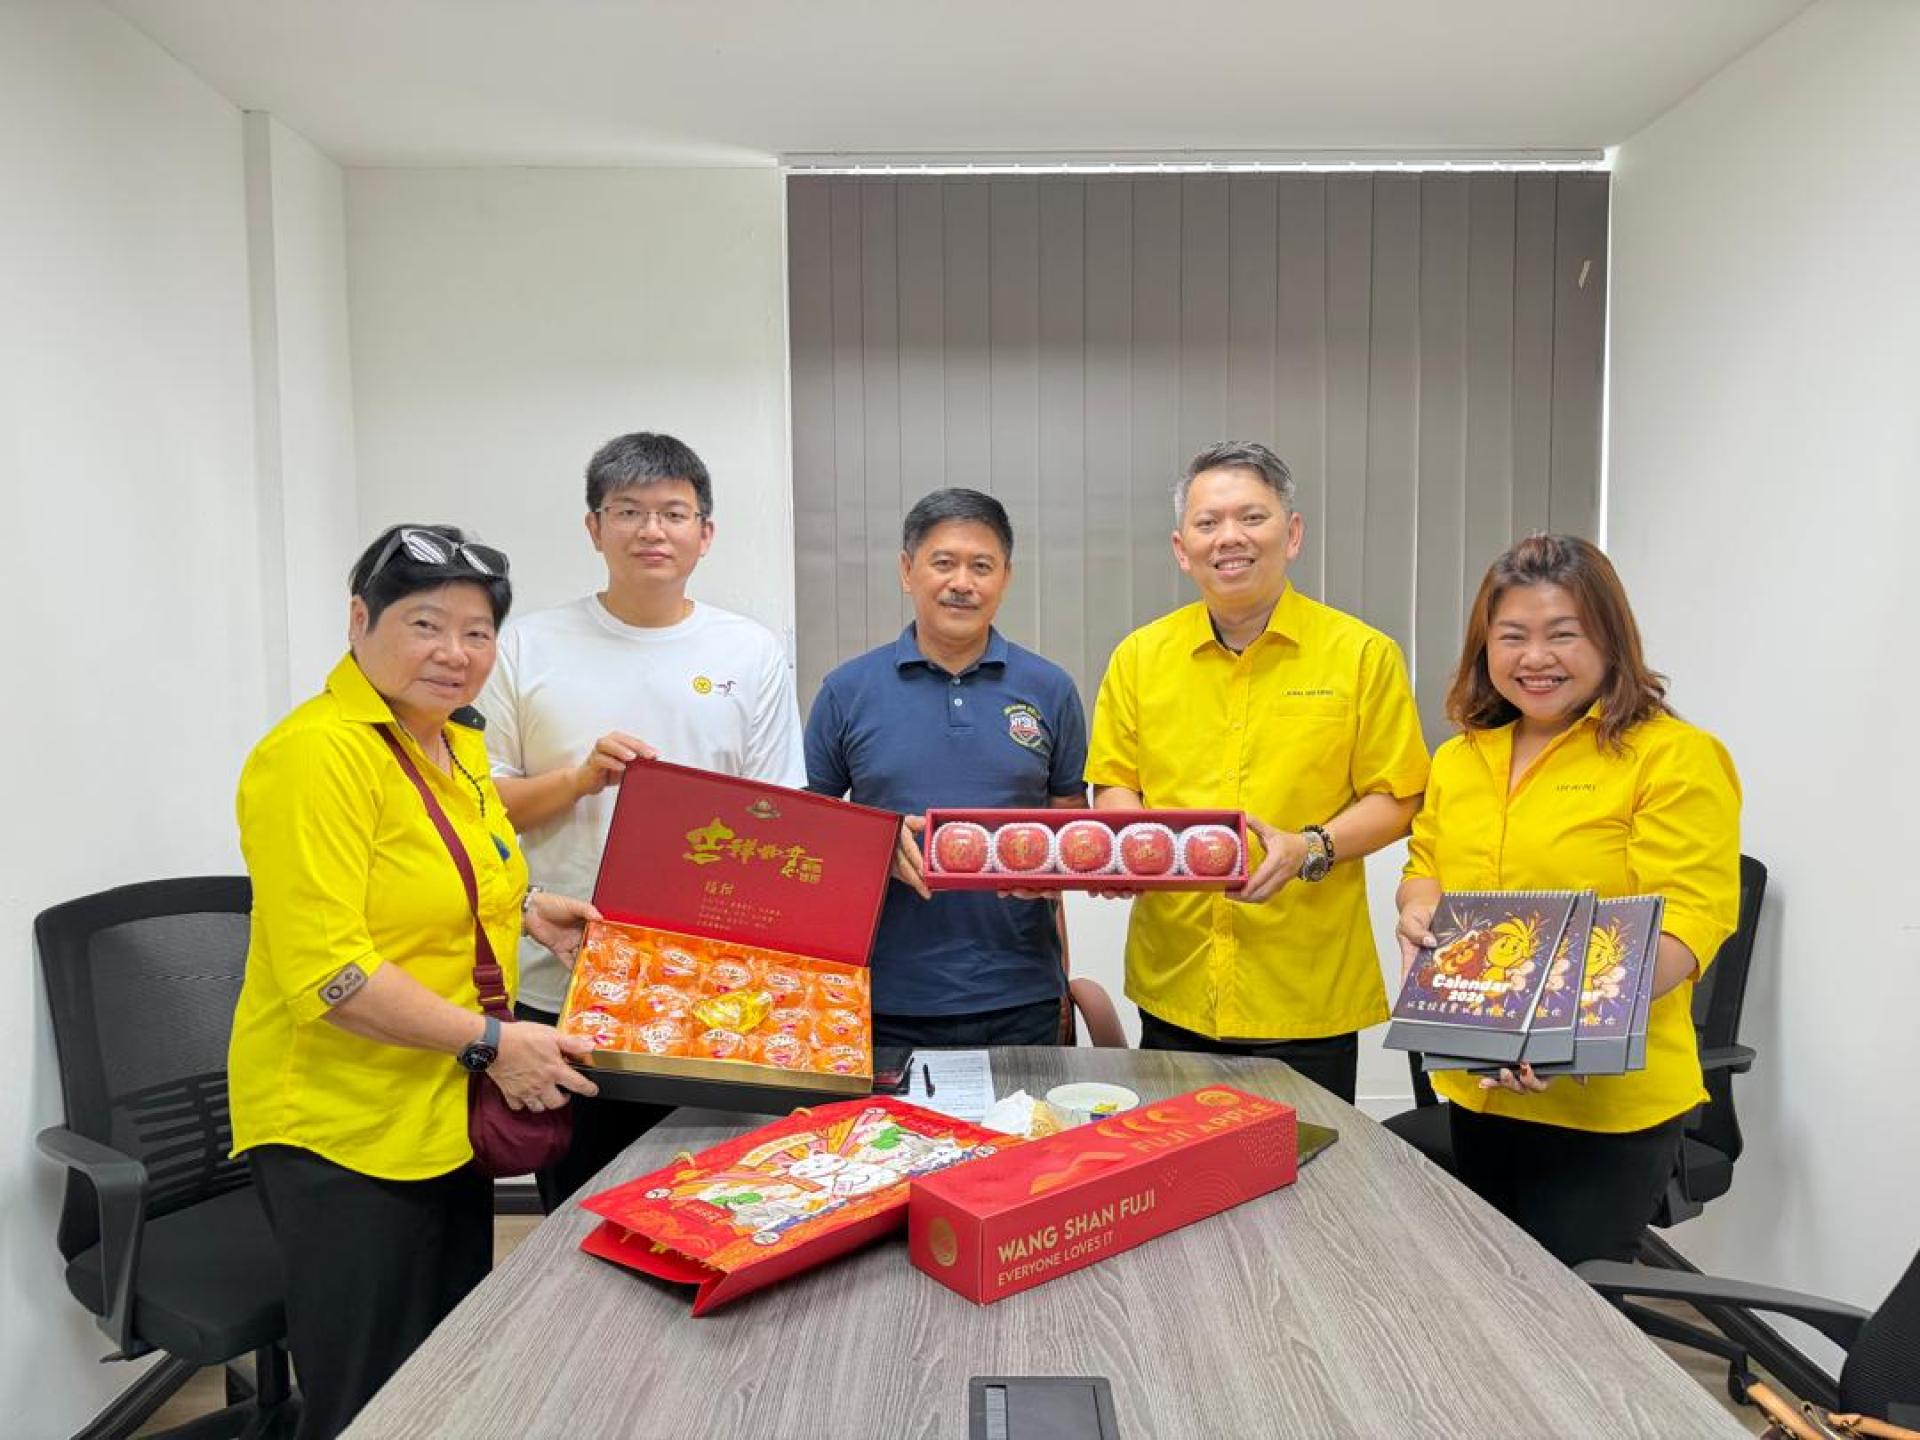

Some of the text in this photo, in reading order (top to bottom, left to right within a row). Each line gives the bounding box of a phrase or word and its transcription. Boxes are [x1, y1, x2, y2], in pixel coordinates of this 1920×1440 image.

[1432, 972, 1511, 993] Calendar
[1131, 1102, 1275, 1153] FUJI APPLE
[998, 1188, 1156, 1265] WANG SHAN FUJI
[998, 1230, 1114, 1288] EVERYONE LOVES IT
